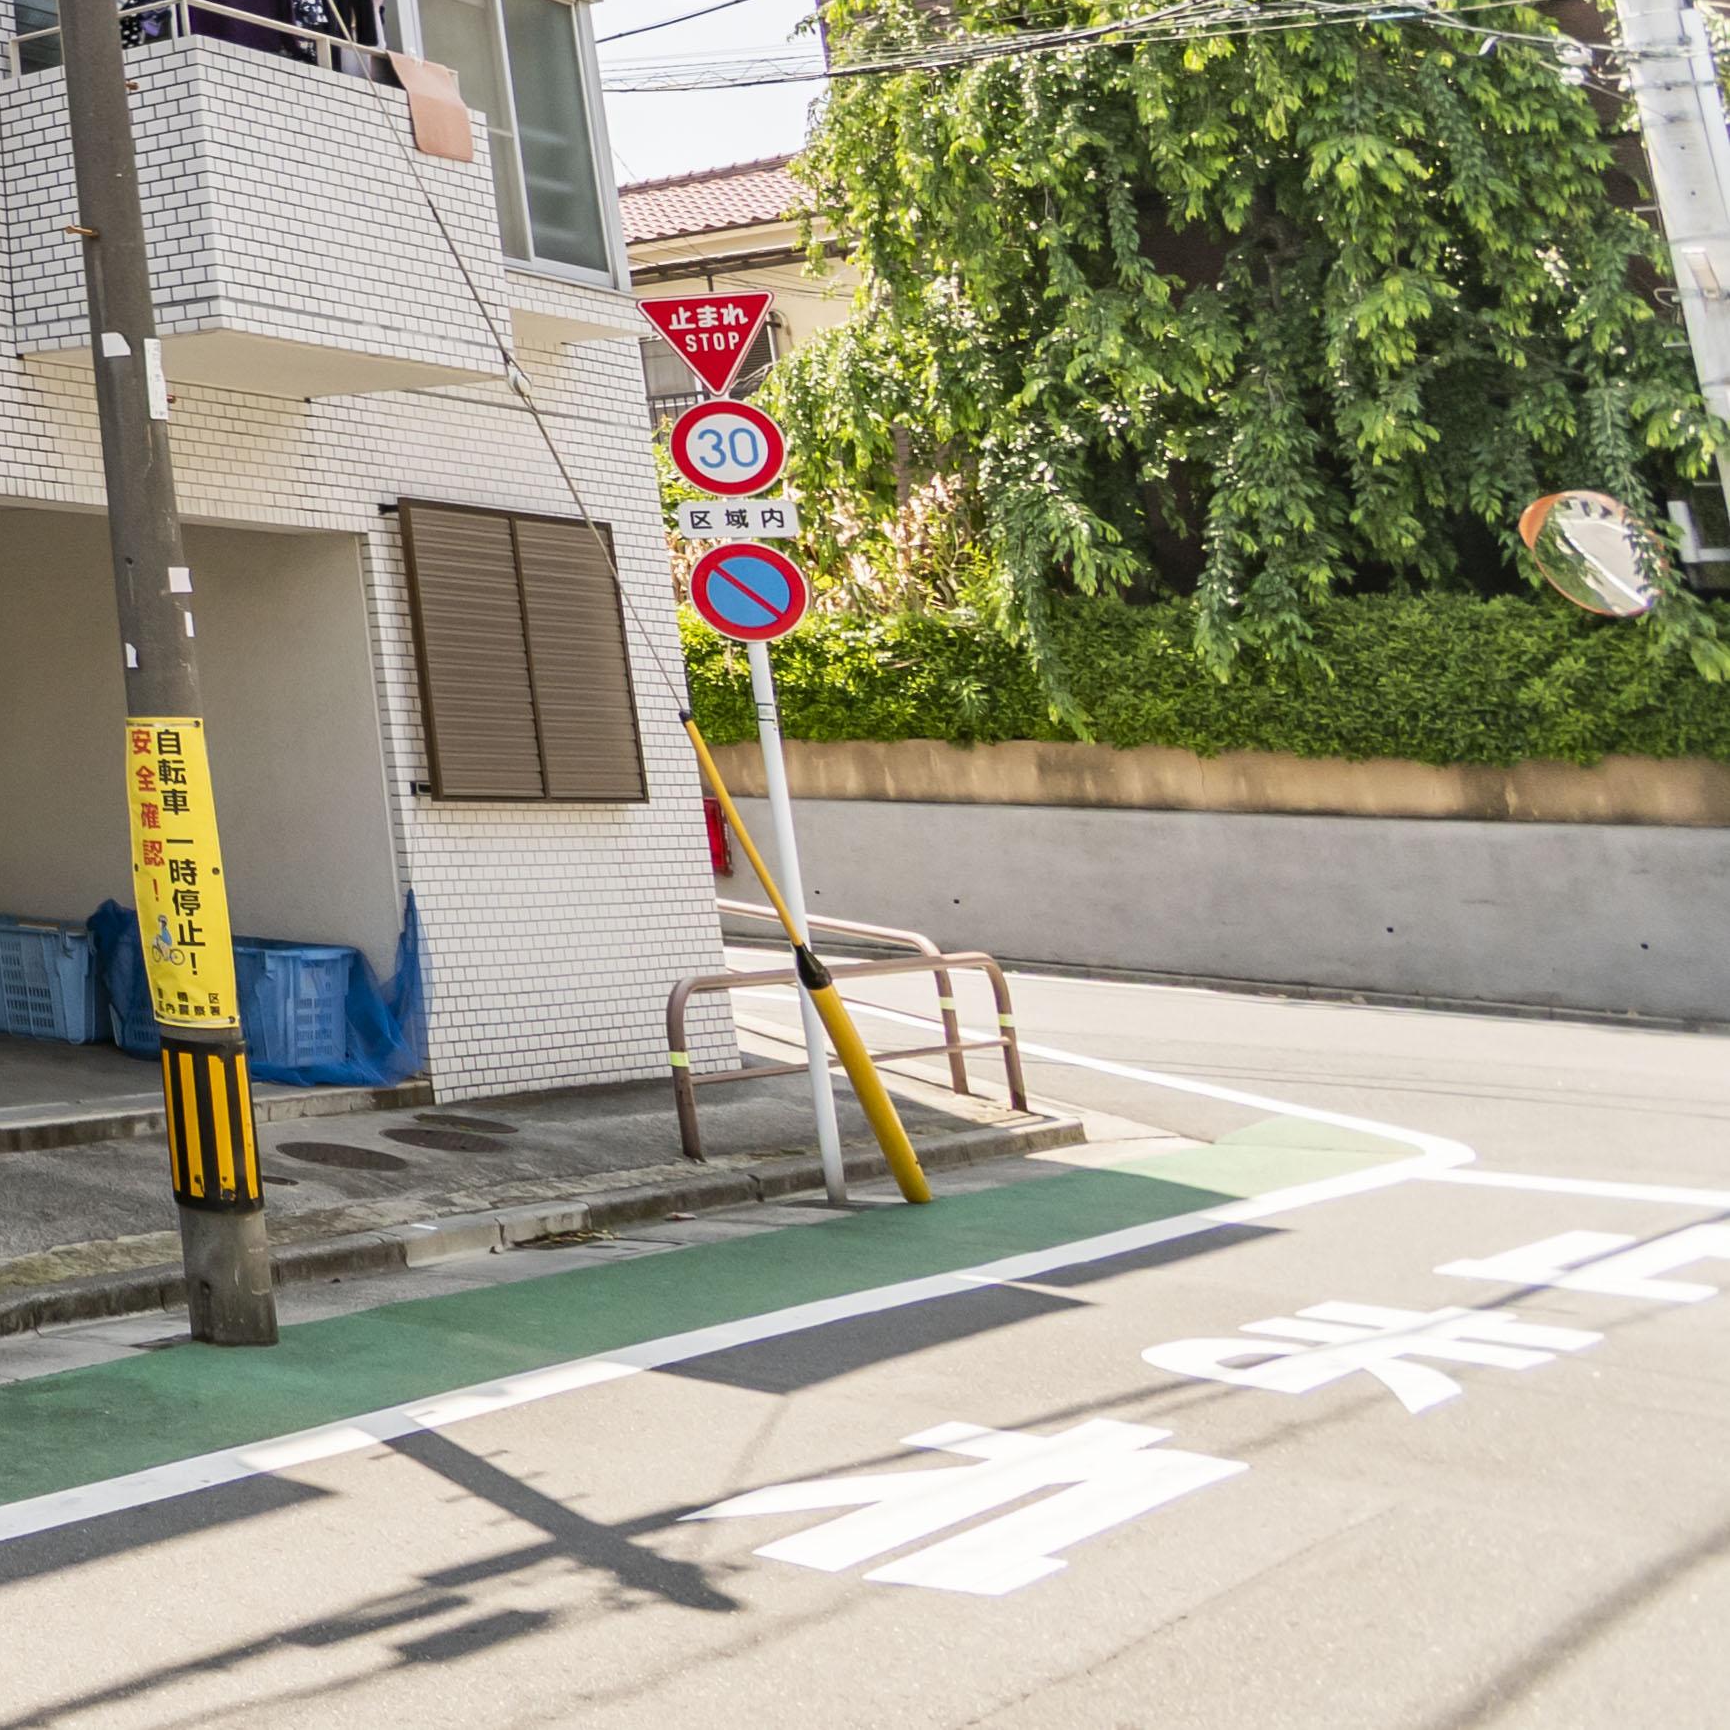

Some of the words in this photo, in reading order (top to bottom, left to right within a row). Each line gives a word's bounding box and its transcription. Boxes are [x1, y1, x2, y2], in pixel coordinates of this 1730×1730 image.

[669, 303, 748, 331] 止まれ
[685, 331, 740, 352] STOP
[697, 427, 759, 469] 30
[689, 507, 786, 531] 区域内
